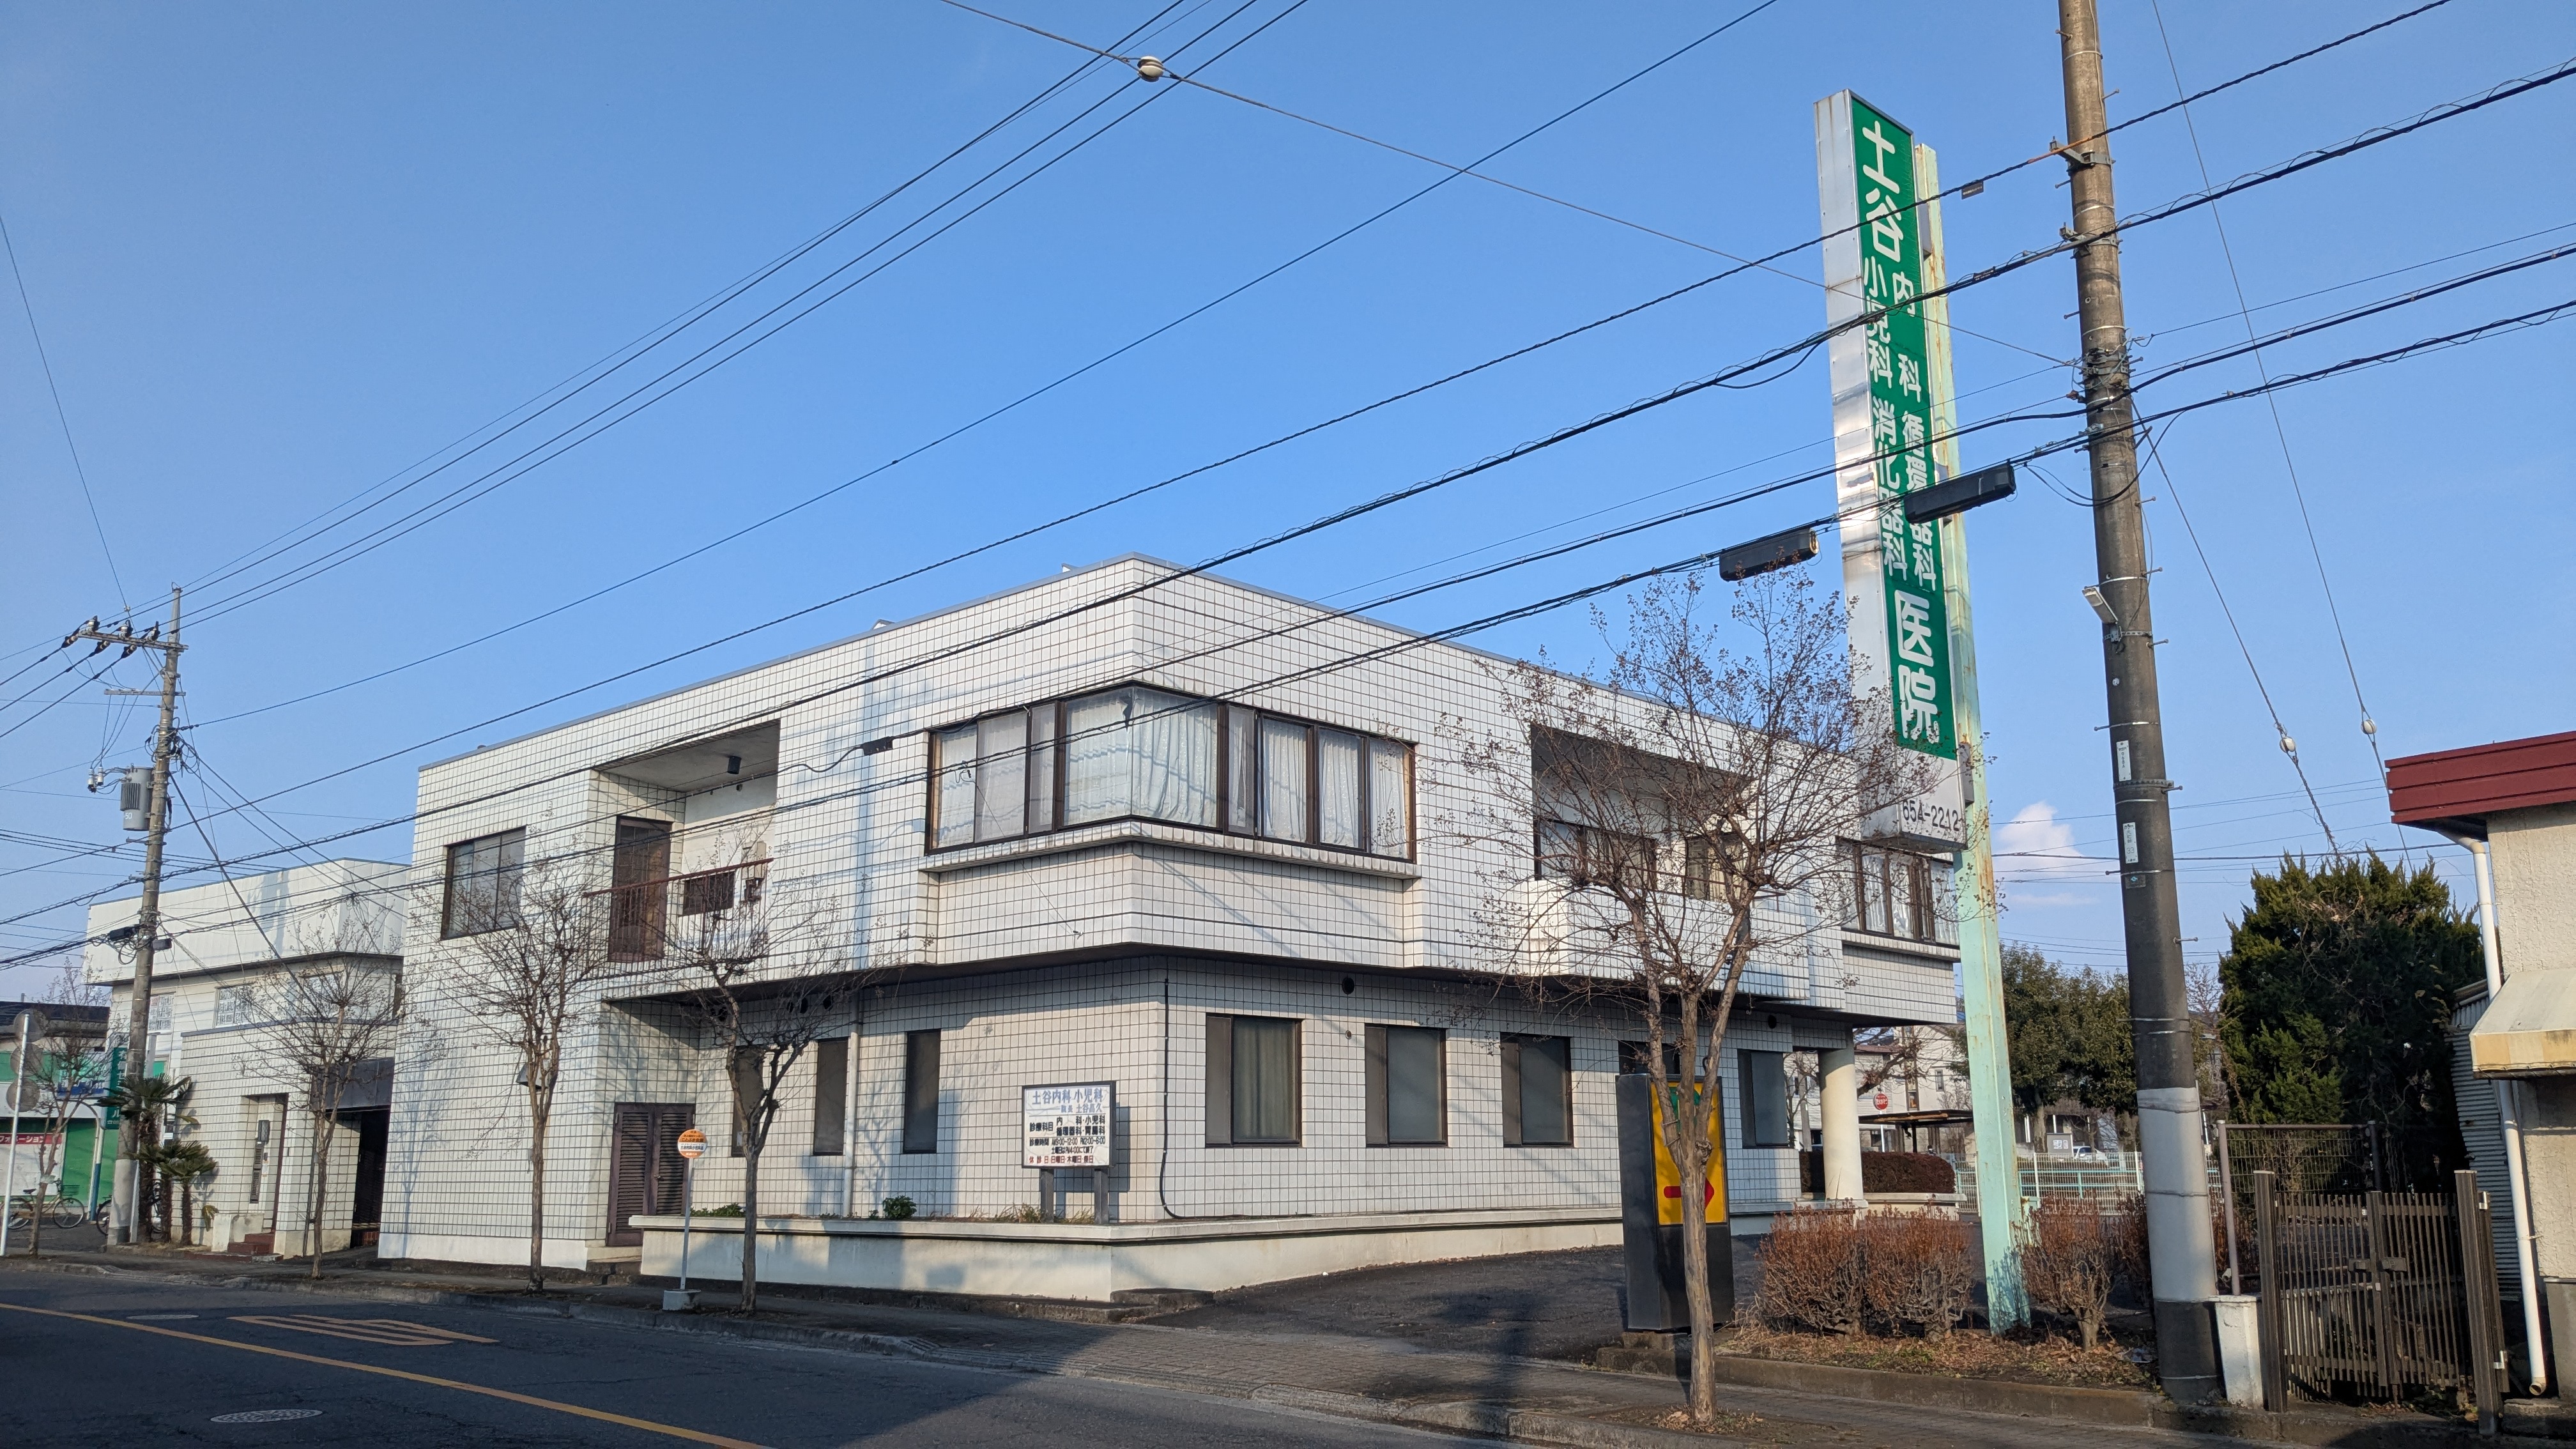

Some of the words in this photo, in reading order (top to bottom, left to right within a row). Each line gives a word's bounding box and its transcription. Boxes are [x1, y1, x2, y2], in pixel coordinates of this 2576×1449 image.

[1862, 120, 1905, 263] 土谷
[1864, 256, 1893, 389] 小児科
[1873, 395, 1908, 581] 消化器科
[1894, 588, 1941, 744] 医院
[1902, 799, 1959, 832] 654-2212
[1029, 1121, 1054, 1132] 診療科目
[1032, 1087, 1103, 1105] 土谷内科小児科
[1029, 1138, 1049, 1146] 診療時間
